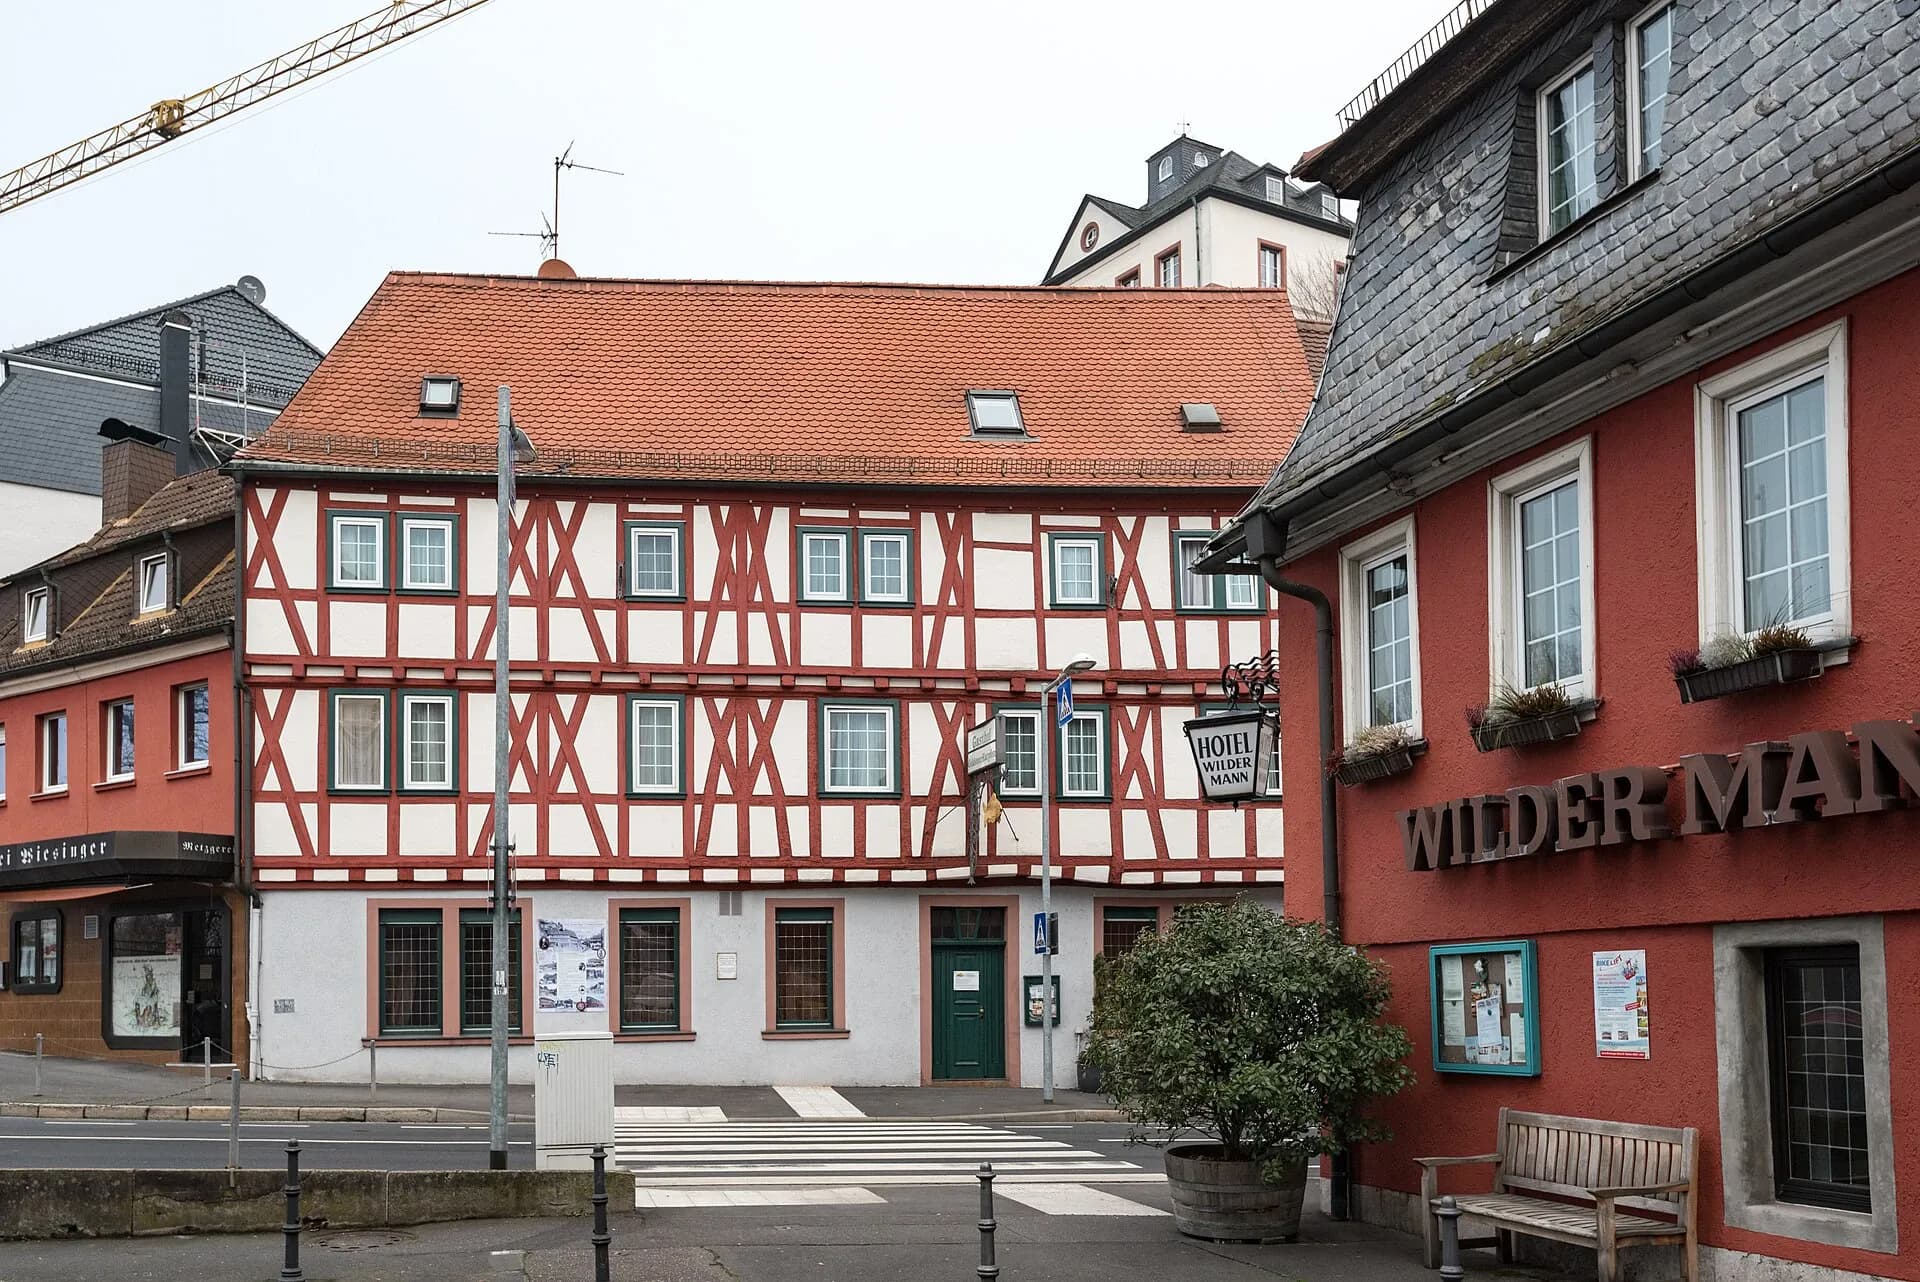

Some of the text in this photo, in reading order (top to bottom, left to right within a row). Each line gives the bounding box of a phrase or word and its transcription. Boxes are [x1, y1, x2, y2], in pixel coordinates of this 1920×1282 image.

[1198, 732, 1253, 760] HOTEL
[1203, 757, 1252, 773] WILDER
[1211, 772, 1249, 787] MANN
[1399, 767, 1672, 871] WILDER
[20, 842, 107, 864] Wiesinger
